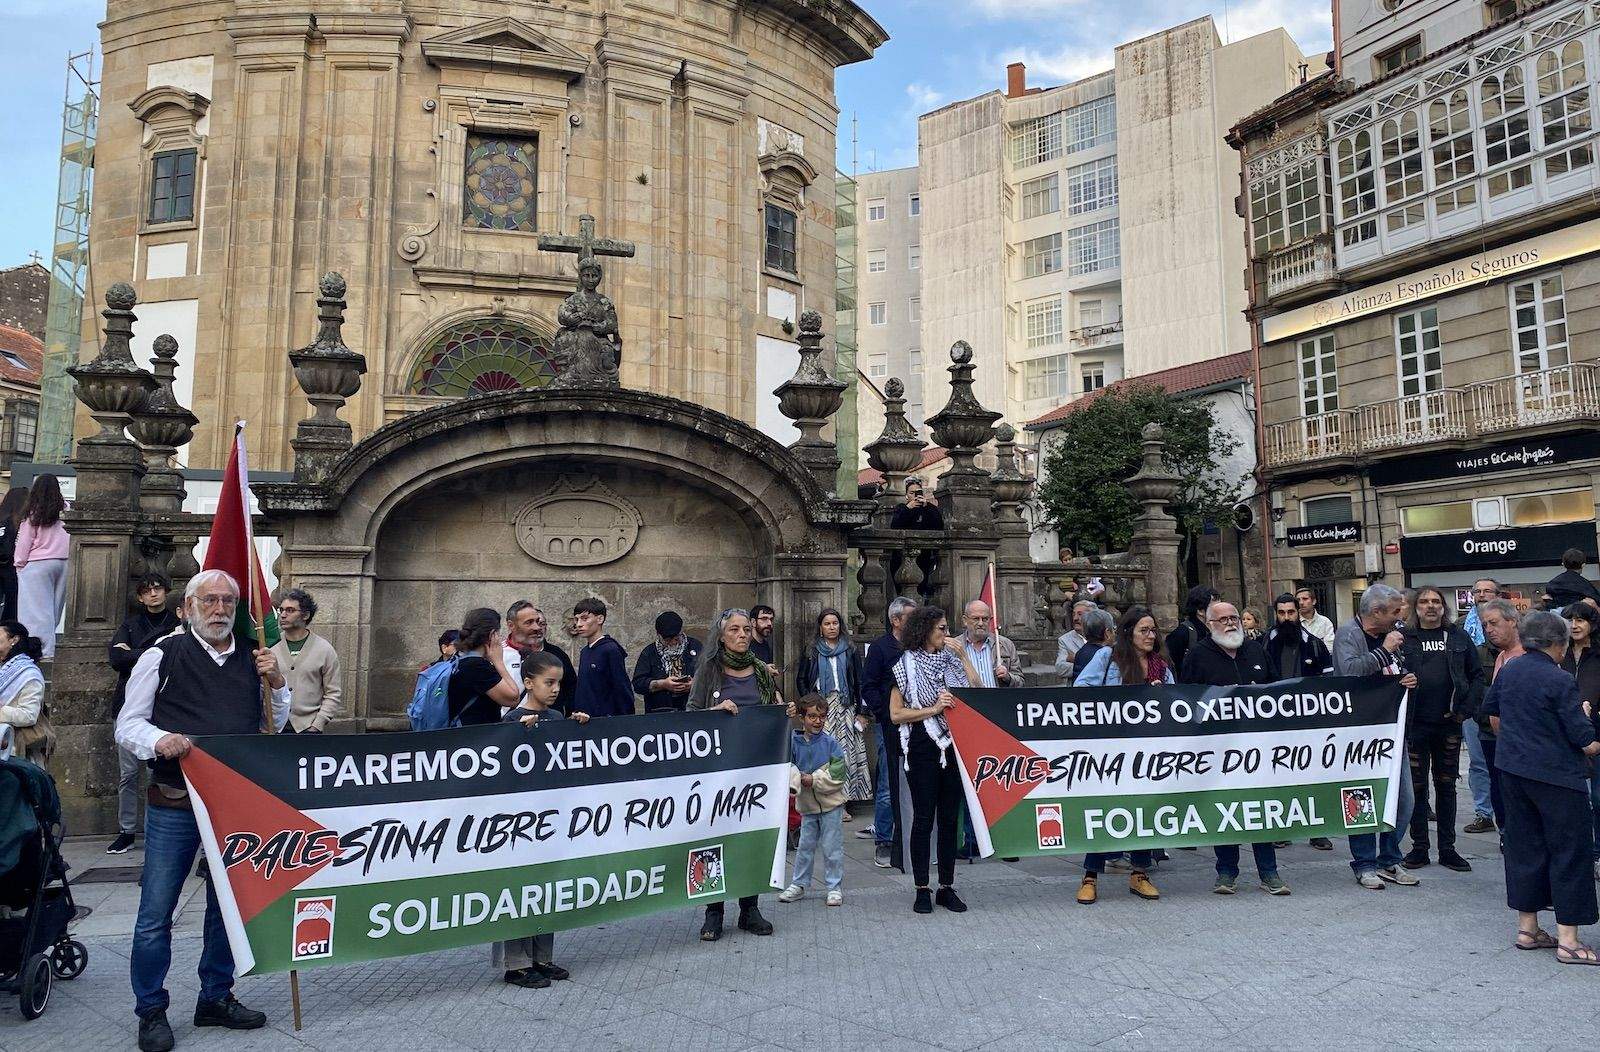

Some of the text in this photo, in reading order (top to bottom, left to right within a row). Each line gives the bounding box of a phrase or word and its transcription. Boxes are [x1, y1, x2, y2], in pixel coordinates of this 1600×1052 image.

[1340, 247, 1539, 315] Alianza Española Seguros
[1456, 458, 1489, 469] VIAJES
[1490, 452, 1500, 464] El
[1500, 451, 1522, 463] Corte
[1522, 446, 1554, 464] Inglés
[1289, 532, 1312, 541] VIAJES
[1463, 539, 1517, 555] Orange
[1016, 691, 1353, 727] ¡PAREMOS O XENOCIDIO!
[298, 729, 722, 790] ¡PAREMOS O XENOCIDIO!
[973, 733, 1395, 793] PALESTINA LIBRE DO RIO Ó MAR
[221, 780, 768, 880] PALESTINA LIBRE DO RIO Ó MAR
[1084, 796, 1325, 840] FOLGA XERAL
[1041, 835, 1062, 847] CGT
[366, 864, 666, 939] SOLIDARIEDADE
[297, 940, 328, 955] CGT
